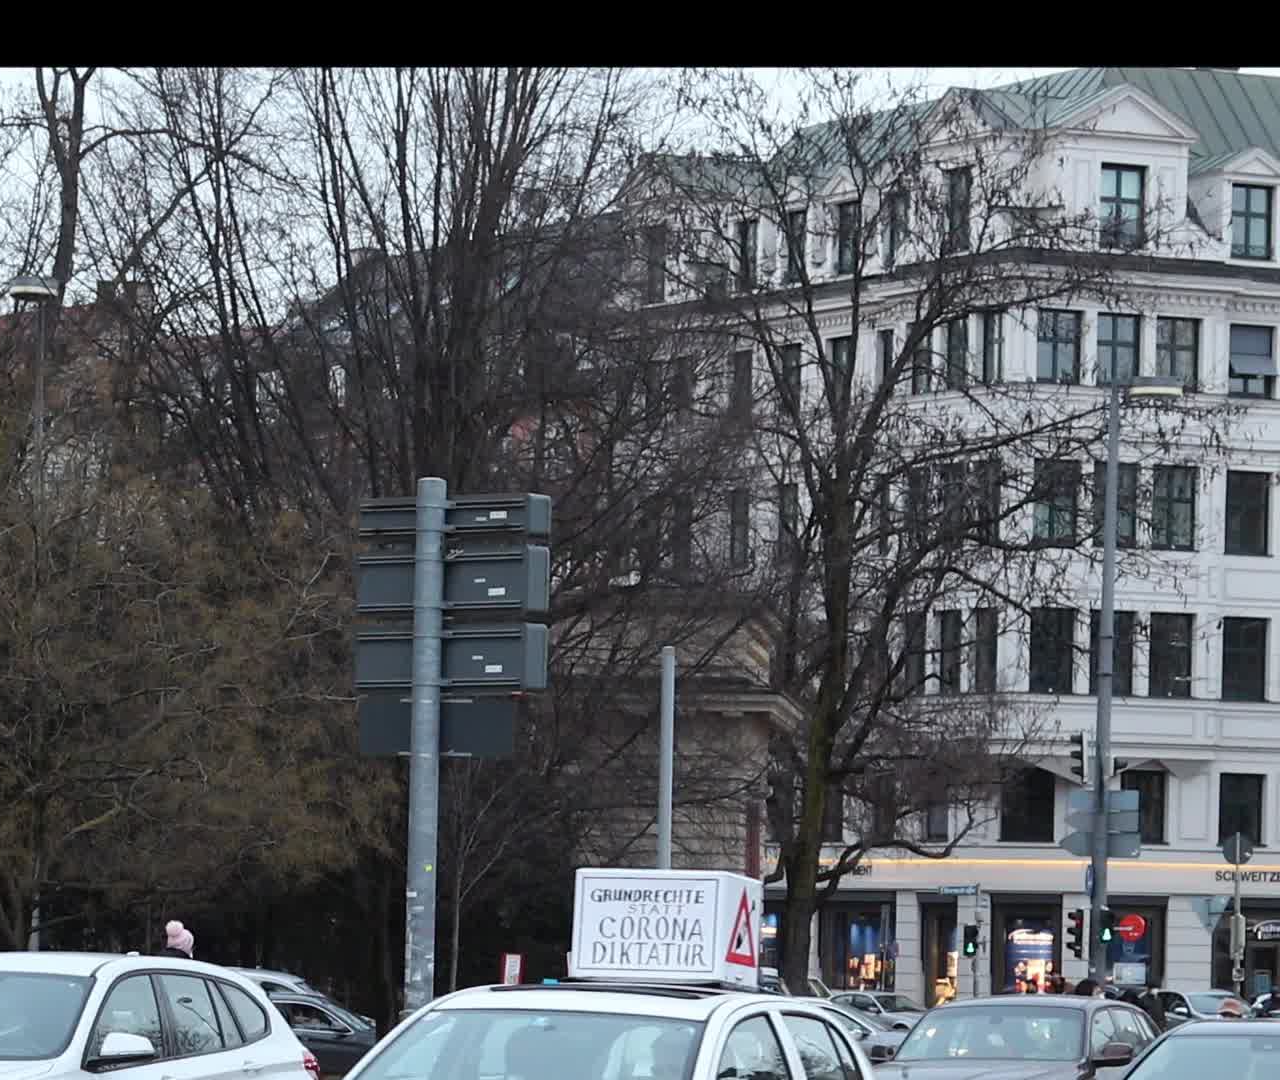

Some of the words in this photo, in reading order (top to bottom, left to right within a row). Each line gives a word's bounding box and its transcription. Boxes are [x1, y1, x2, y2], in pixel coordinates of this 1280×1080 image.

[590, 888, 705, 904] GRUNDRECHTE
[628, 904, 685, 915] STATT
[599, 916, 703, 941] CORONA
[592, 941, 707, 966] DIKTATUR
